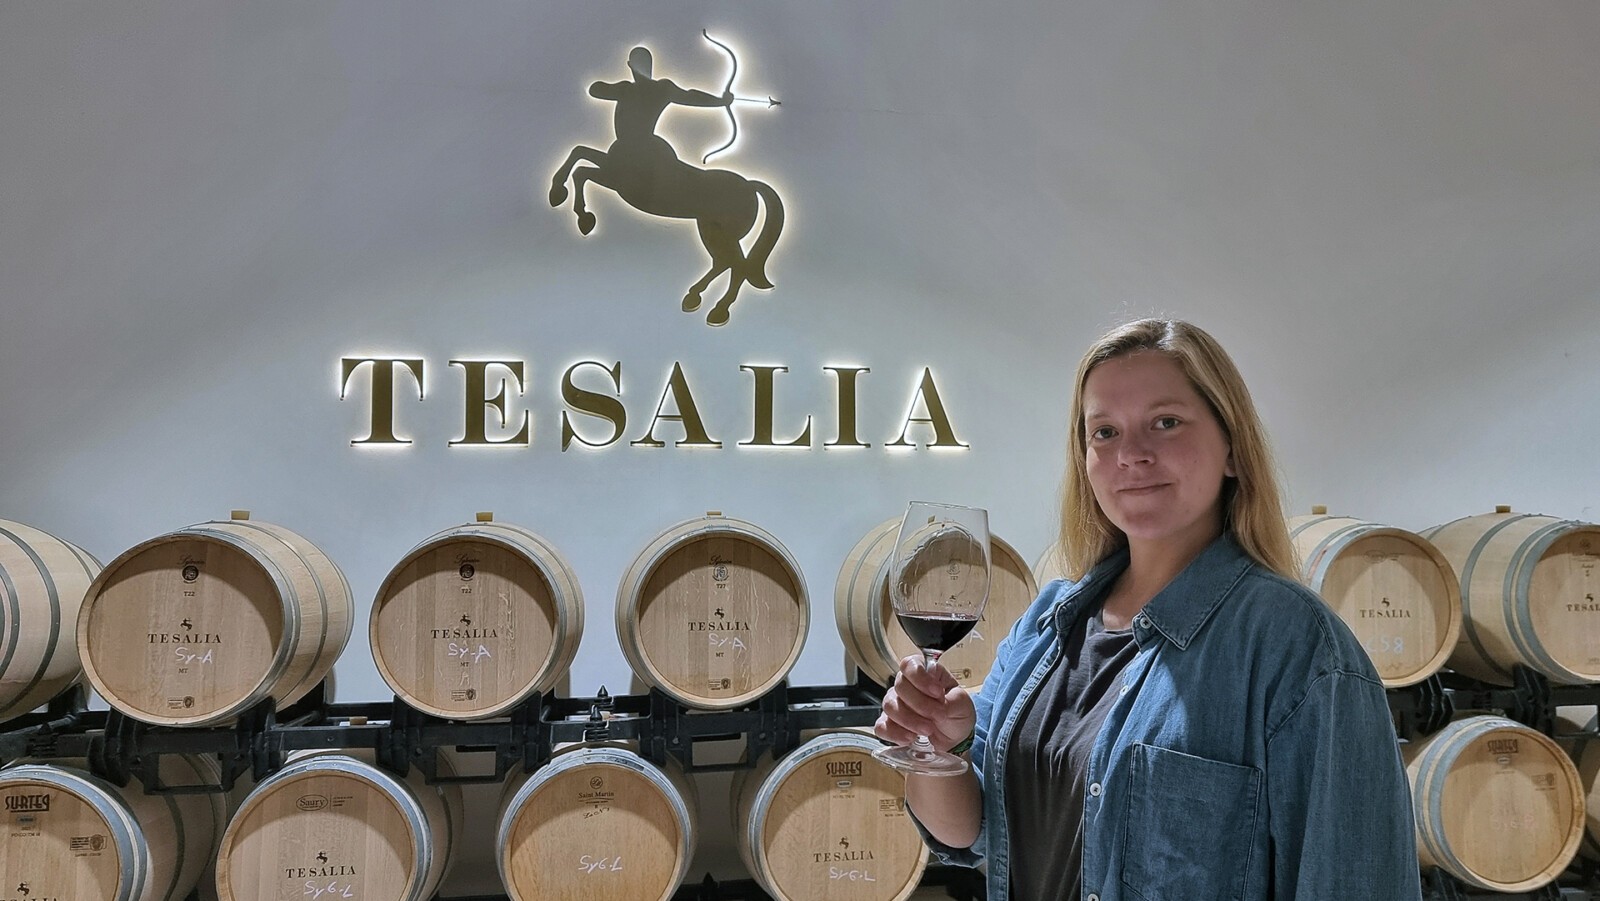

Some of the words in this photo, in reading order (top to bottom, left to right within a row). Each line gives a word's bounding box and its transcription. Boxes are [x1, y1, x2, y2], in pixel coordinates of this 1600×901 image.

[341, 357, 969, 451] TESALIA
[1360, 609, 1411, 618] TESALIA
[688, 621, 750, 631] TESALIA
[147, 633, 222, 644] TESALIA
[431, 629, 498, 639] TESALIA
[300, 798, 325, 808] Saury
[814, 851, 873, 862] TESALIA
[286, 866, 356, 878] TESALIA
